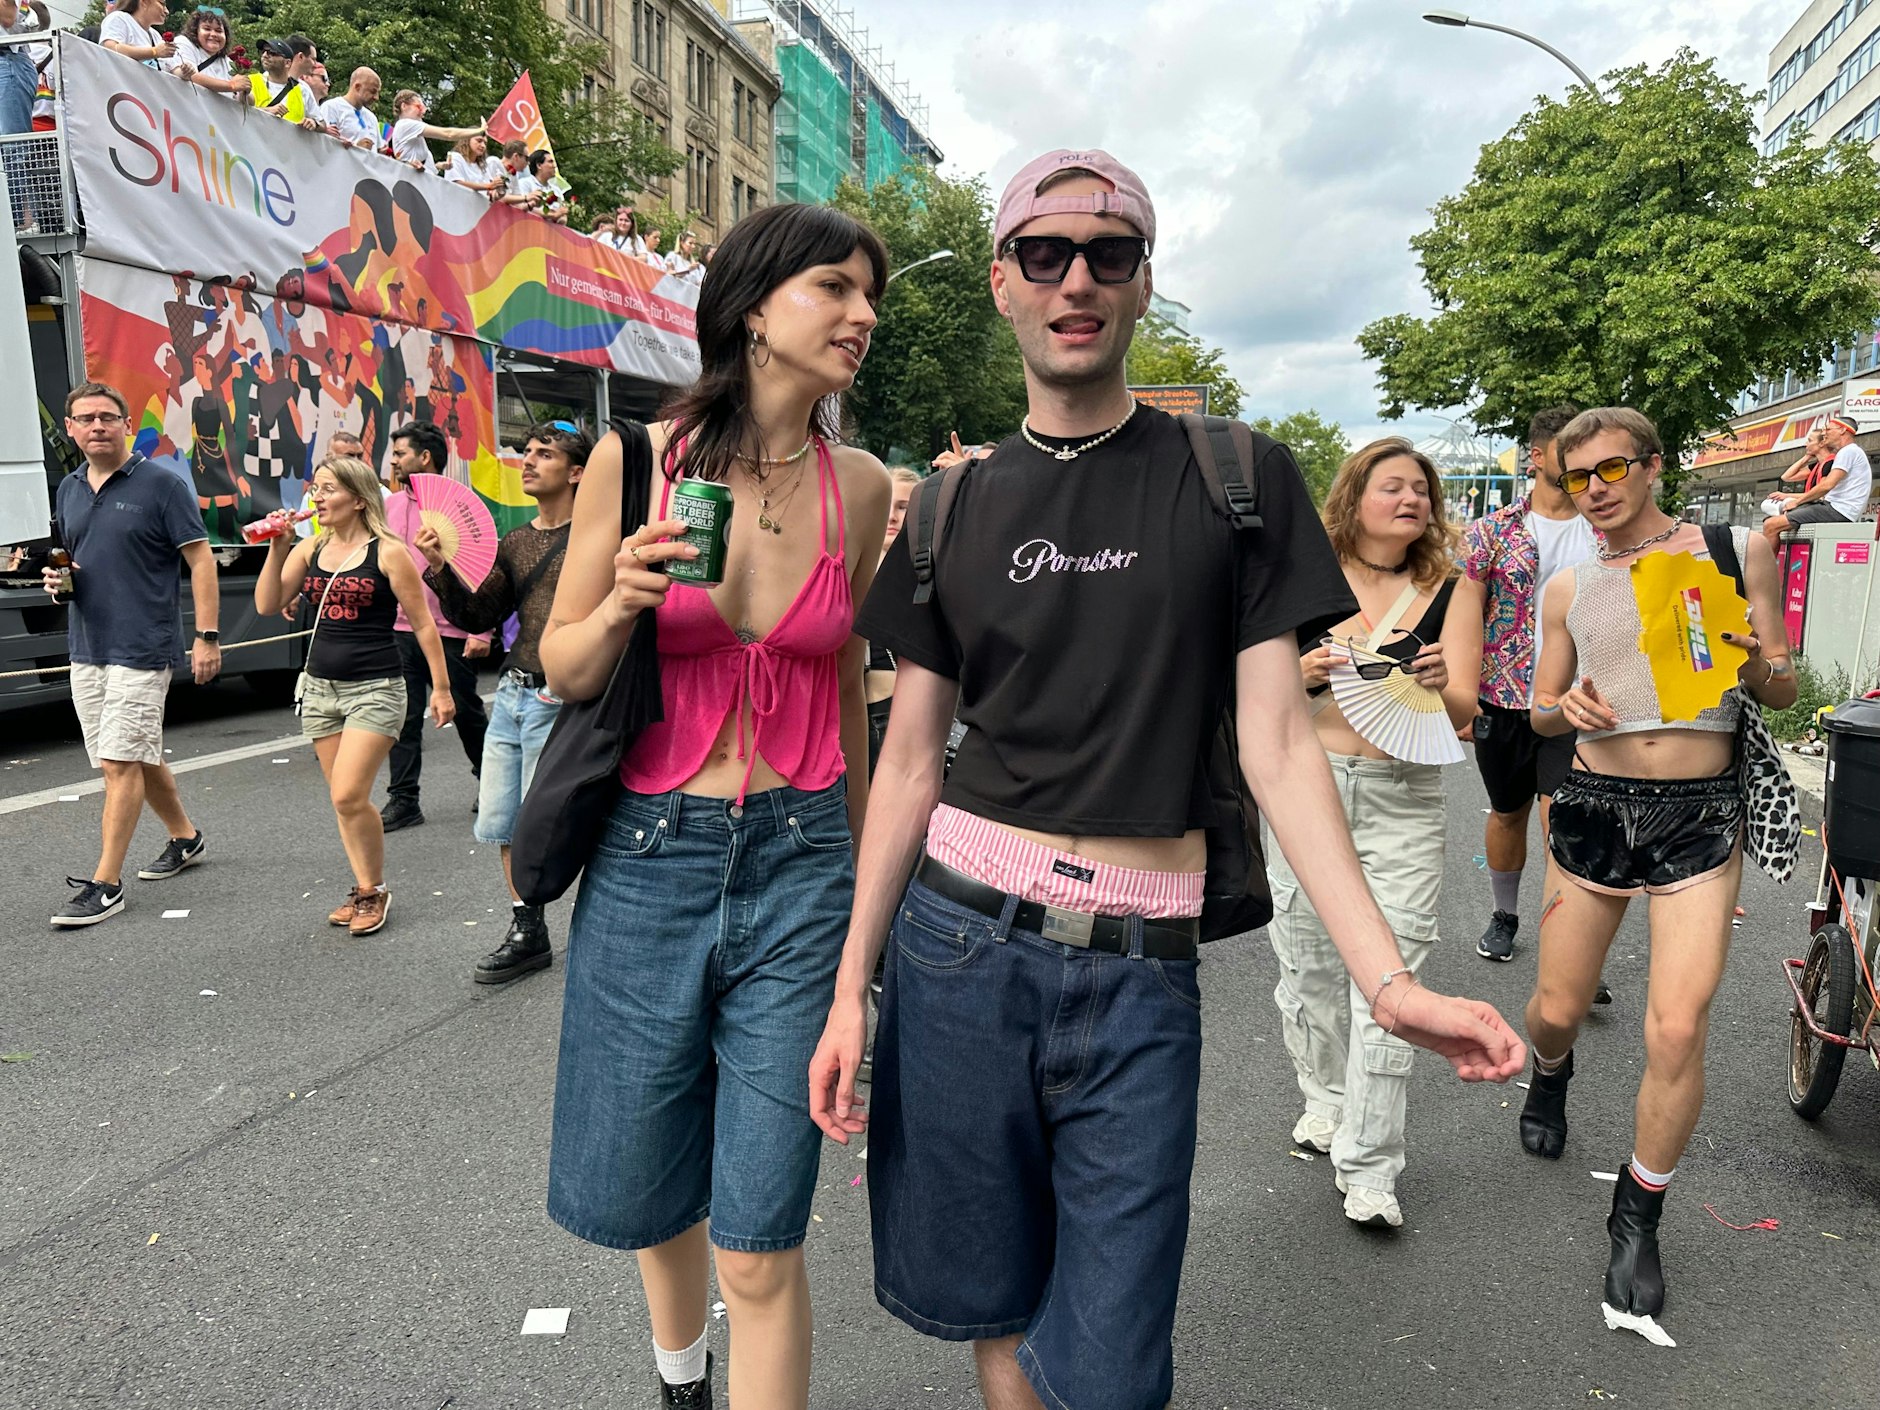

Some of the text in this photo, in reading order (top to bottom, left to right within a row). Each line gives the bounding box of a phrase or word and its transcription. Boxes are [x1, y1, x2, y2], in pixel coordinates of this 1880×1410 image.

[107, 92, 296, 227] Shine
[1060, 154, 1092, 163] POLO
[550, 266, 569, 288] Nur
[571, 279, 623, 306] gemeinsam
[650, 302, 663, 320] für
[678, 498, 716, 510] PROBABLY
[688, 507, 716, 520] BEER
[684, 516, 715, 528] WORLD
[320, 604, 359, 620] YOU
[1673, 604, 1683, 632] Delivered
[1684, 598, 1708, 661] DHL
